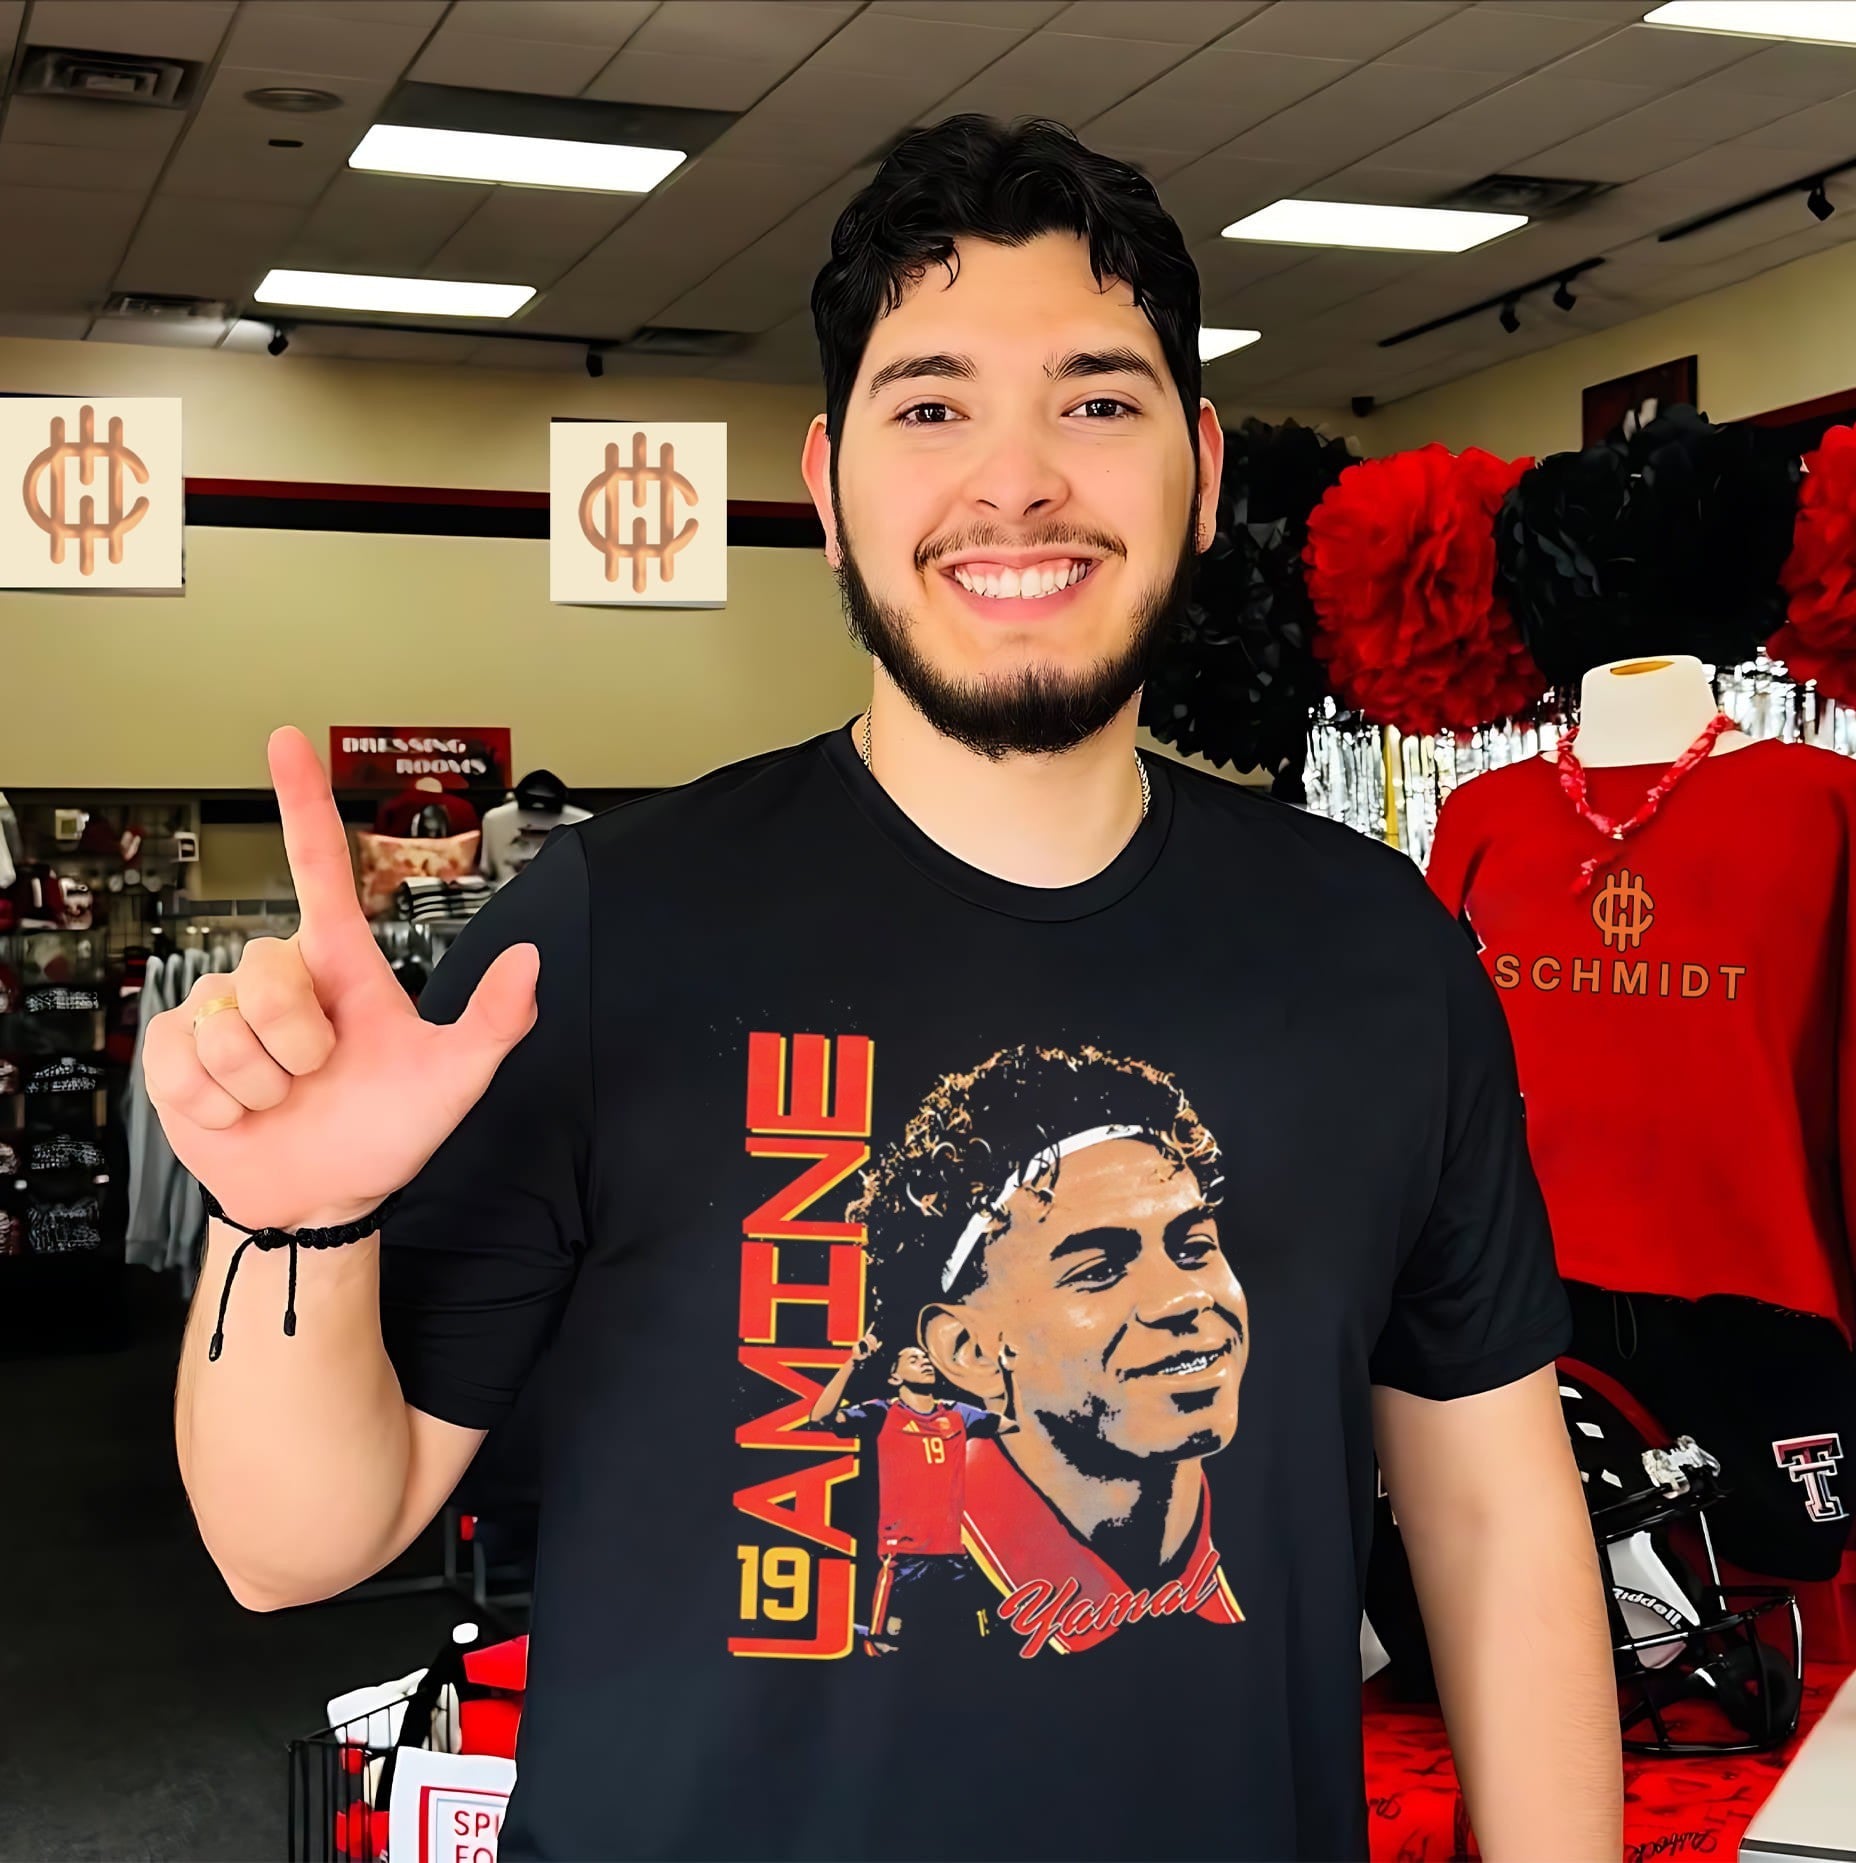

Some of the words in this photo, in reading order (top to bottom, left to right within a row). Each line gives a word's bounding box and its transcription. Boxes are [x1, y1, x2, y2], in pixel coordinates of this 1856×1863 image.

[342, 737, 467, 754] DRESSING
[397, 758, 487, 775] ROOMS
[1494, 954, 1746, 1000] SCHMIDT
[728, 1032, 874, 1660] LAMINE
[922, 1437, 946, 1464] 19
[737, 1545, 810, 1621] 19
[997, 1549, 1220, 1659] Yamal
